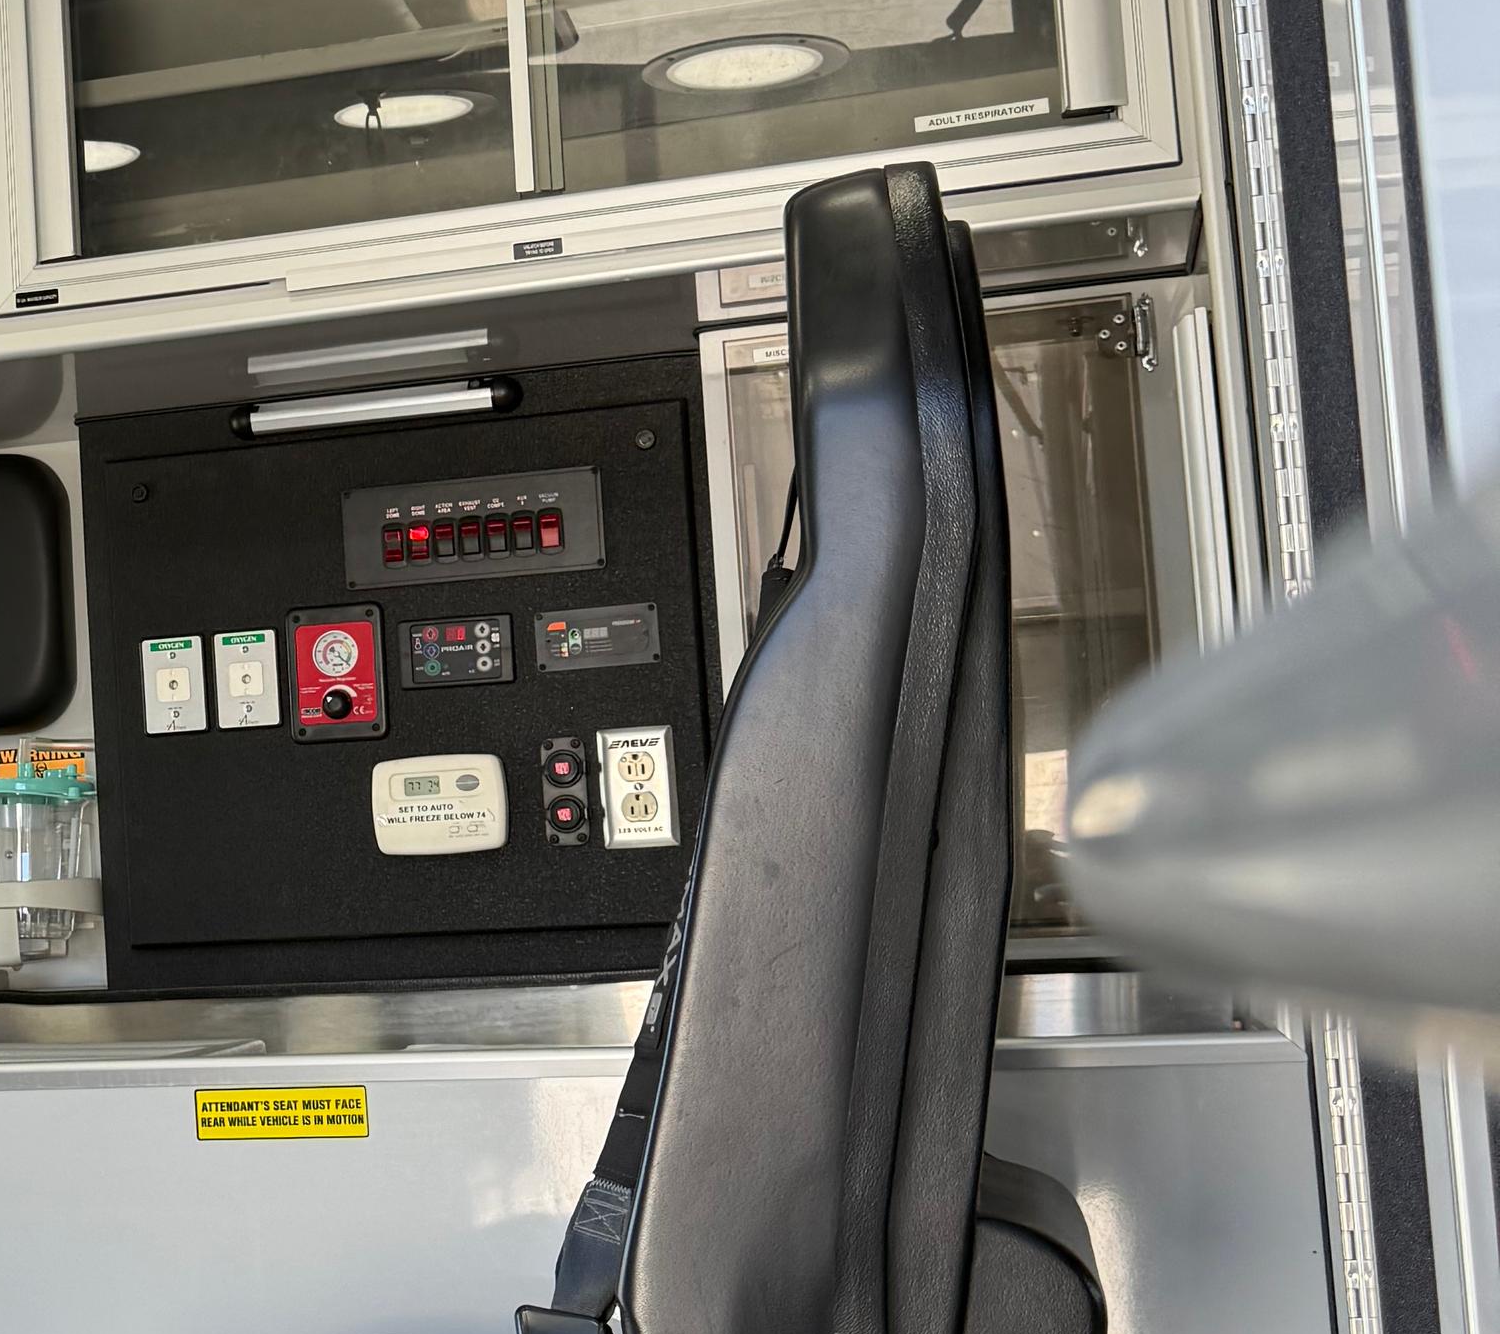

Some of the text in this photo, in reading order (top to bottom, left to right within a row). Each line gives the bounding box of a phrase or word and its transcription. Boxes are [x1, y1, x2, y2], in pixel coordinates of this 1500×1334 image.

[928, 104, 1035, 127] ADULT RESPIRATORY
[158, 642, 185, 650] OXYGEN
[230, 636, 257, 644] OXYGEN
[441, 644, 473, 653] PROAIR
[0, 750, 82, 763] WRNING
[398, 806, 414, 814] SET
[430, 803, 454, 811] AUTO
[387, 811, 486, 824] WILL FREEZE BELOW 74
[201, 1098, 362, 1112] ATTENDANT'S SEAT MUST FACE
[201, 1113, 364, 1128] REAR WHILE VEHICLE IS IN MOTION
